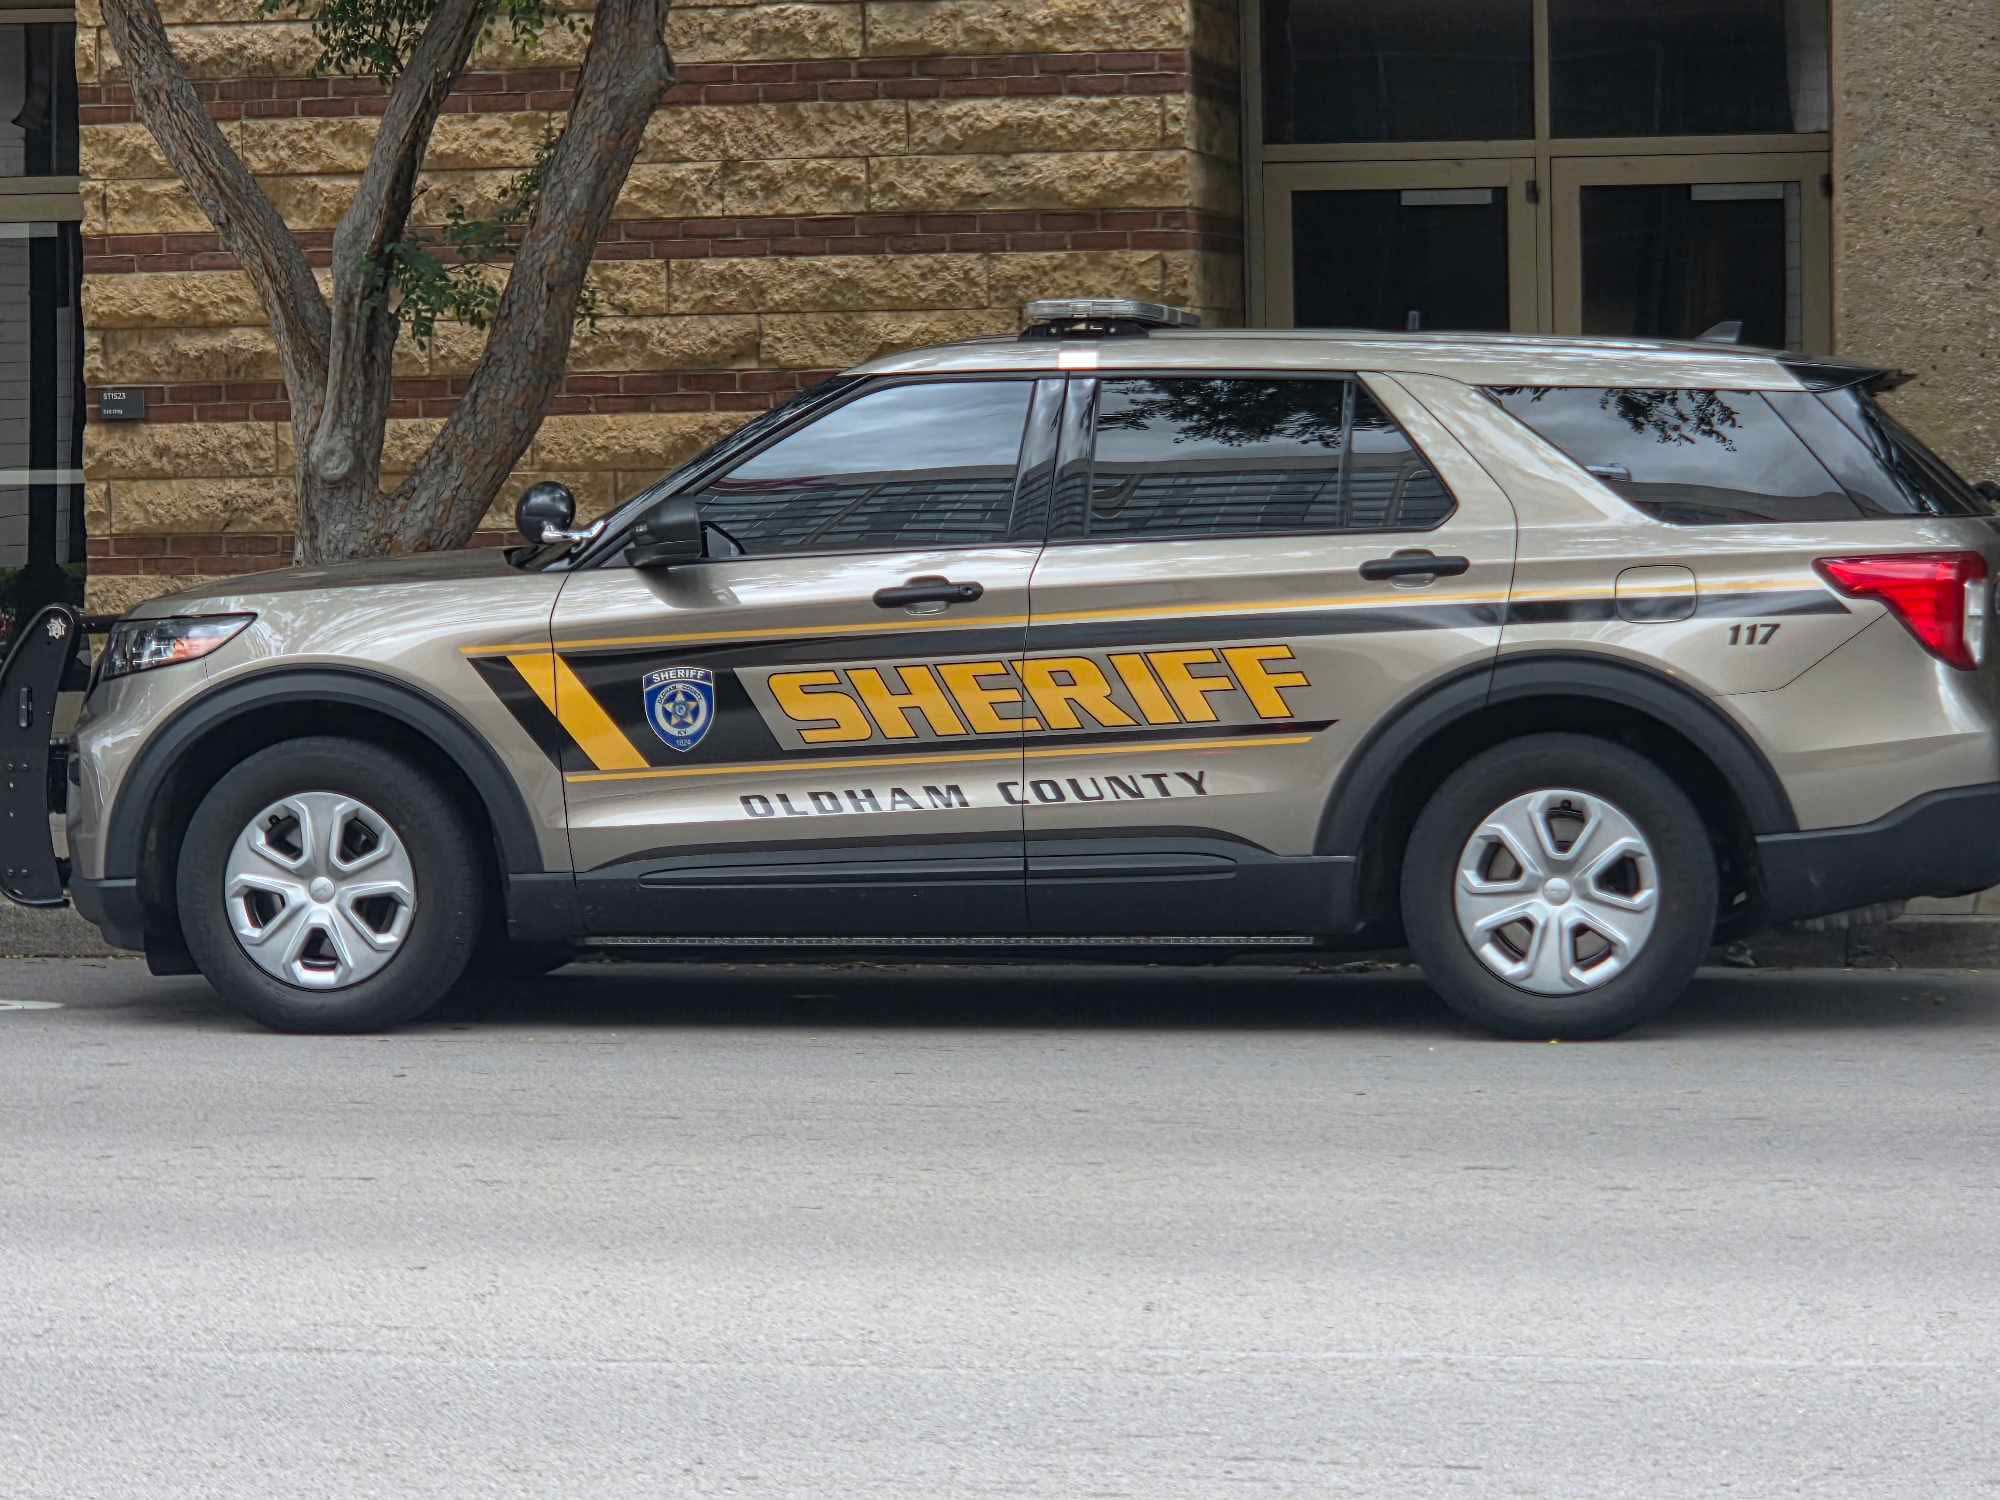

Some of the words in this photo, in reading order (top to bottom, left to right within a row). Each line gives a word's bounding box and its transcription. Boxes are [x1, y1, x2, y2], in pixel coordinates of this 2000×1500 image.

[1728, 623, 1781, 646] 117
[652, 669, 705, 683] SHERIFF
[767, 645, 1311, 744] SHERIFF
[739, 784, 970, 819] OLDHAM
[996, 771, 1208, 805] COUNTY
